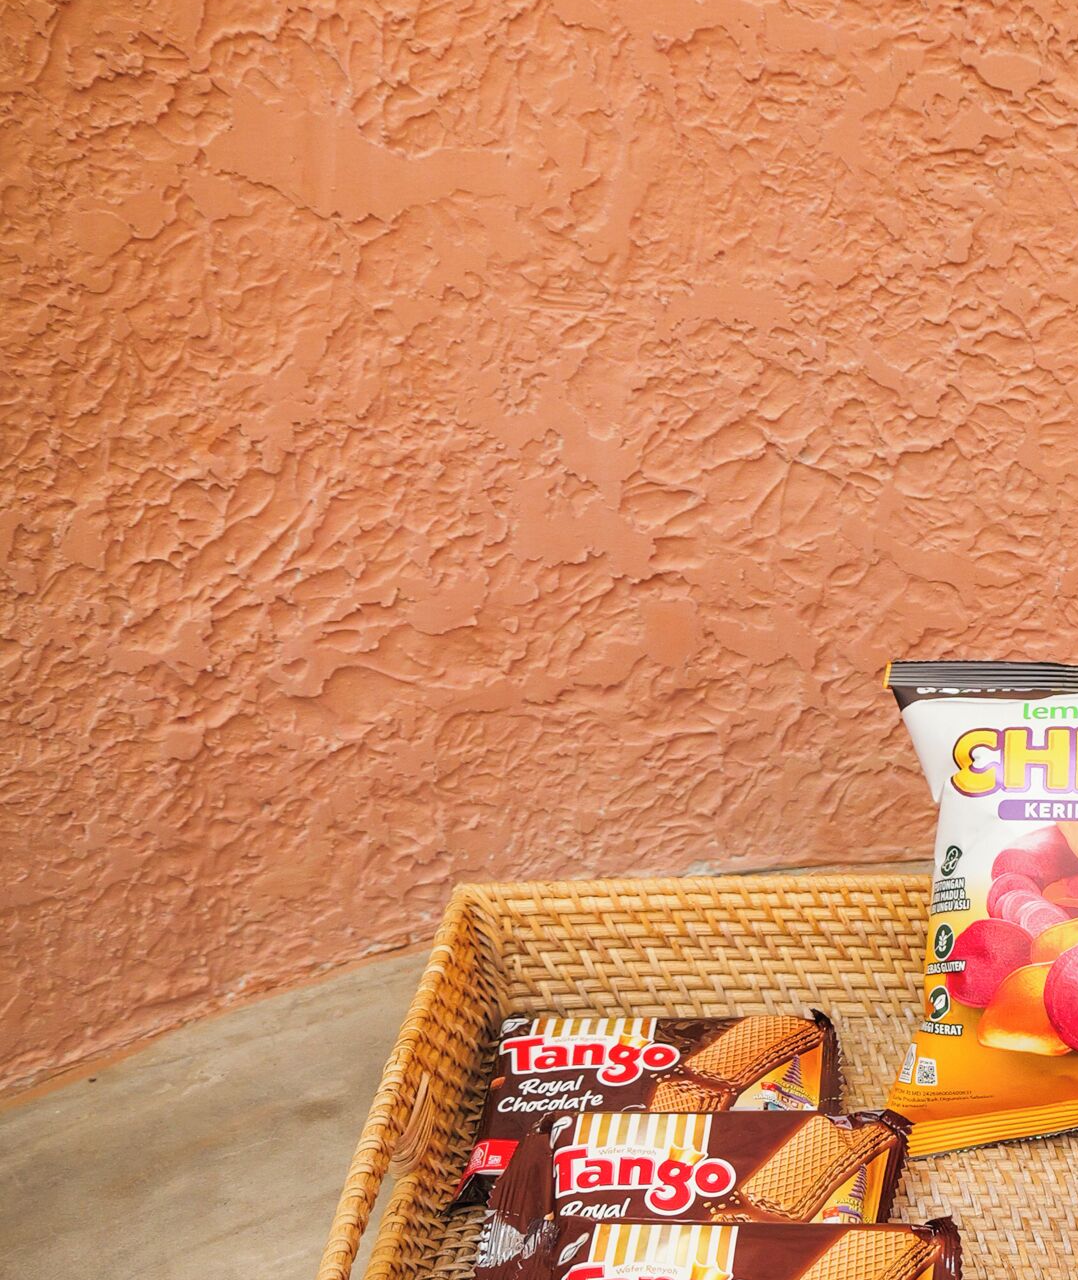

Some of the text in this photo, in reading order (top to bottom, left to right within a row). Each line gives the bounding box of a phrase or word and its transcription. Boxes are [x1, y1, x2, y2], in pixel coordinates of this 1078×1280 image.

[940, 961, 966, 973] GLUTEN
[934, 1024, 962, 1035] SERAT
[501, 1036, 679, 1085] Tango
[518, 1075, 584, 1096] Royal
[497, 1090, 604, 1113] Chocolate
[554, 1146, 735, 1213] Tango
[559, 1197, 632, 1218] Royal
[615, 1265, 643, 1275] Wafer
